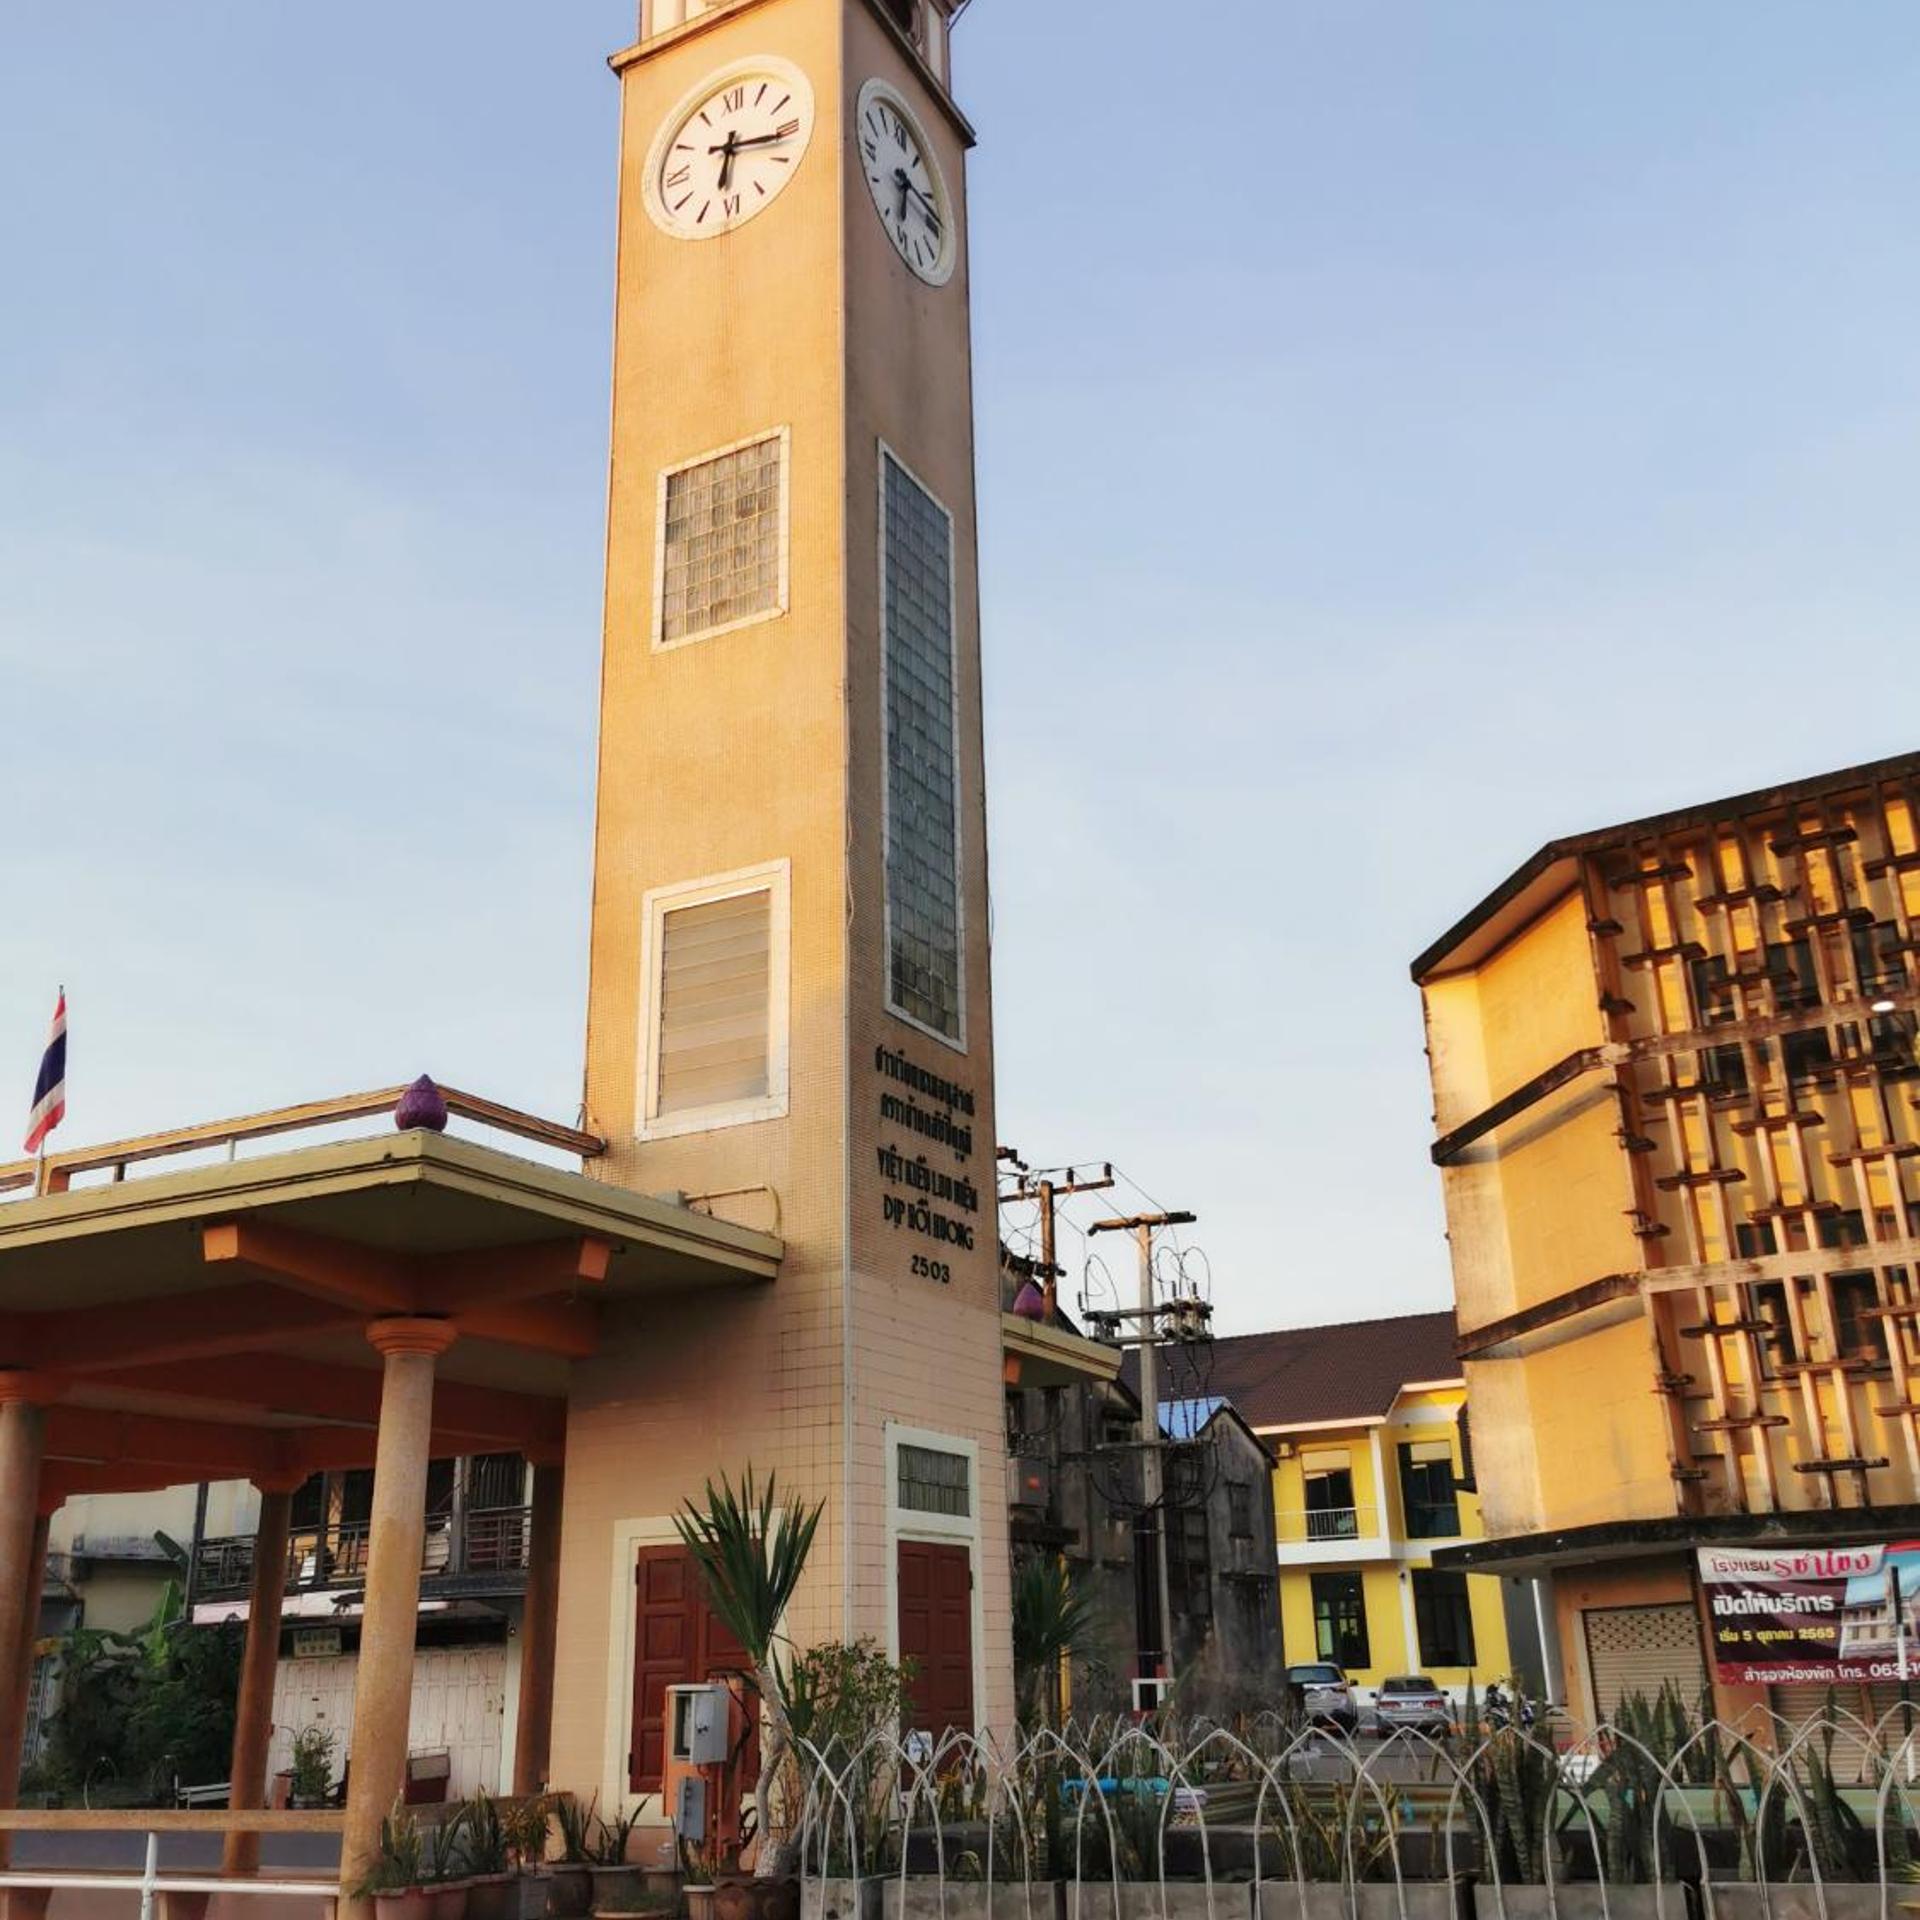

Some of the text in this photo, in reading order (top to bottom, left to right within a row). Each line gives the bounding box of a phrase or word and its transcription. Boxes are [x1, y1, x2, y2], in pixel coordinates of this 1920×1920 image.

[722, 86, 744, 117] XII
[911, 1254, 951, 1285] 2503
[1711, 1557, 1771, 1573] โรงแรม
[1712, 1589, 1835, 1615] เปิดให้บริการ
[1742, 1629, 1752, 1642] 5
[1798, 1626, 1835, 1640] 2565
[1743, 1665, 1836, 1682] สำรองห้องพัก
[1837, 1663, 1866, 1679] โทร.
